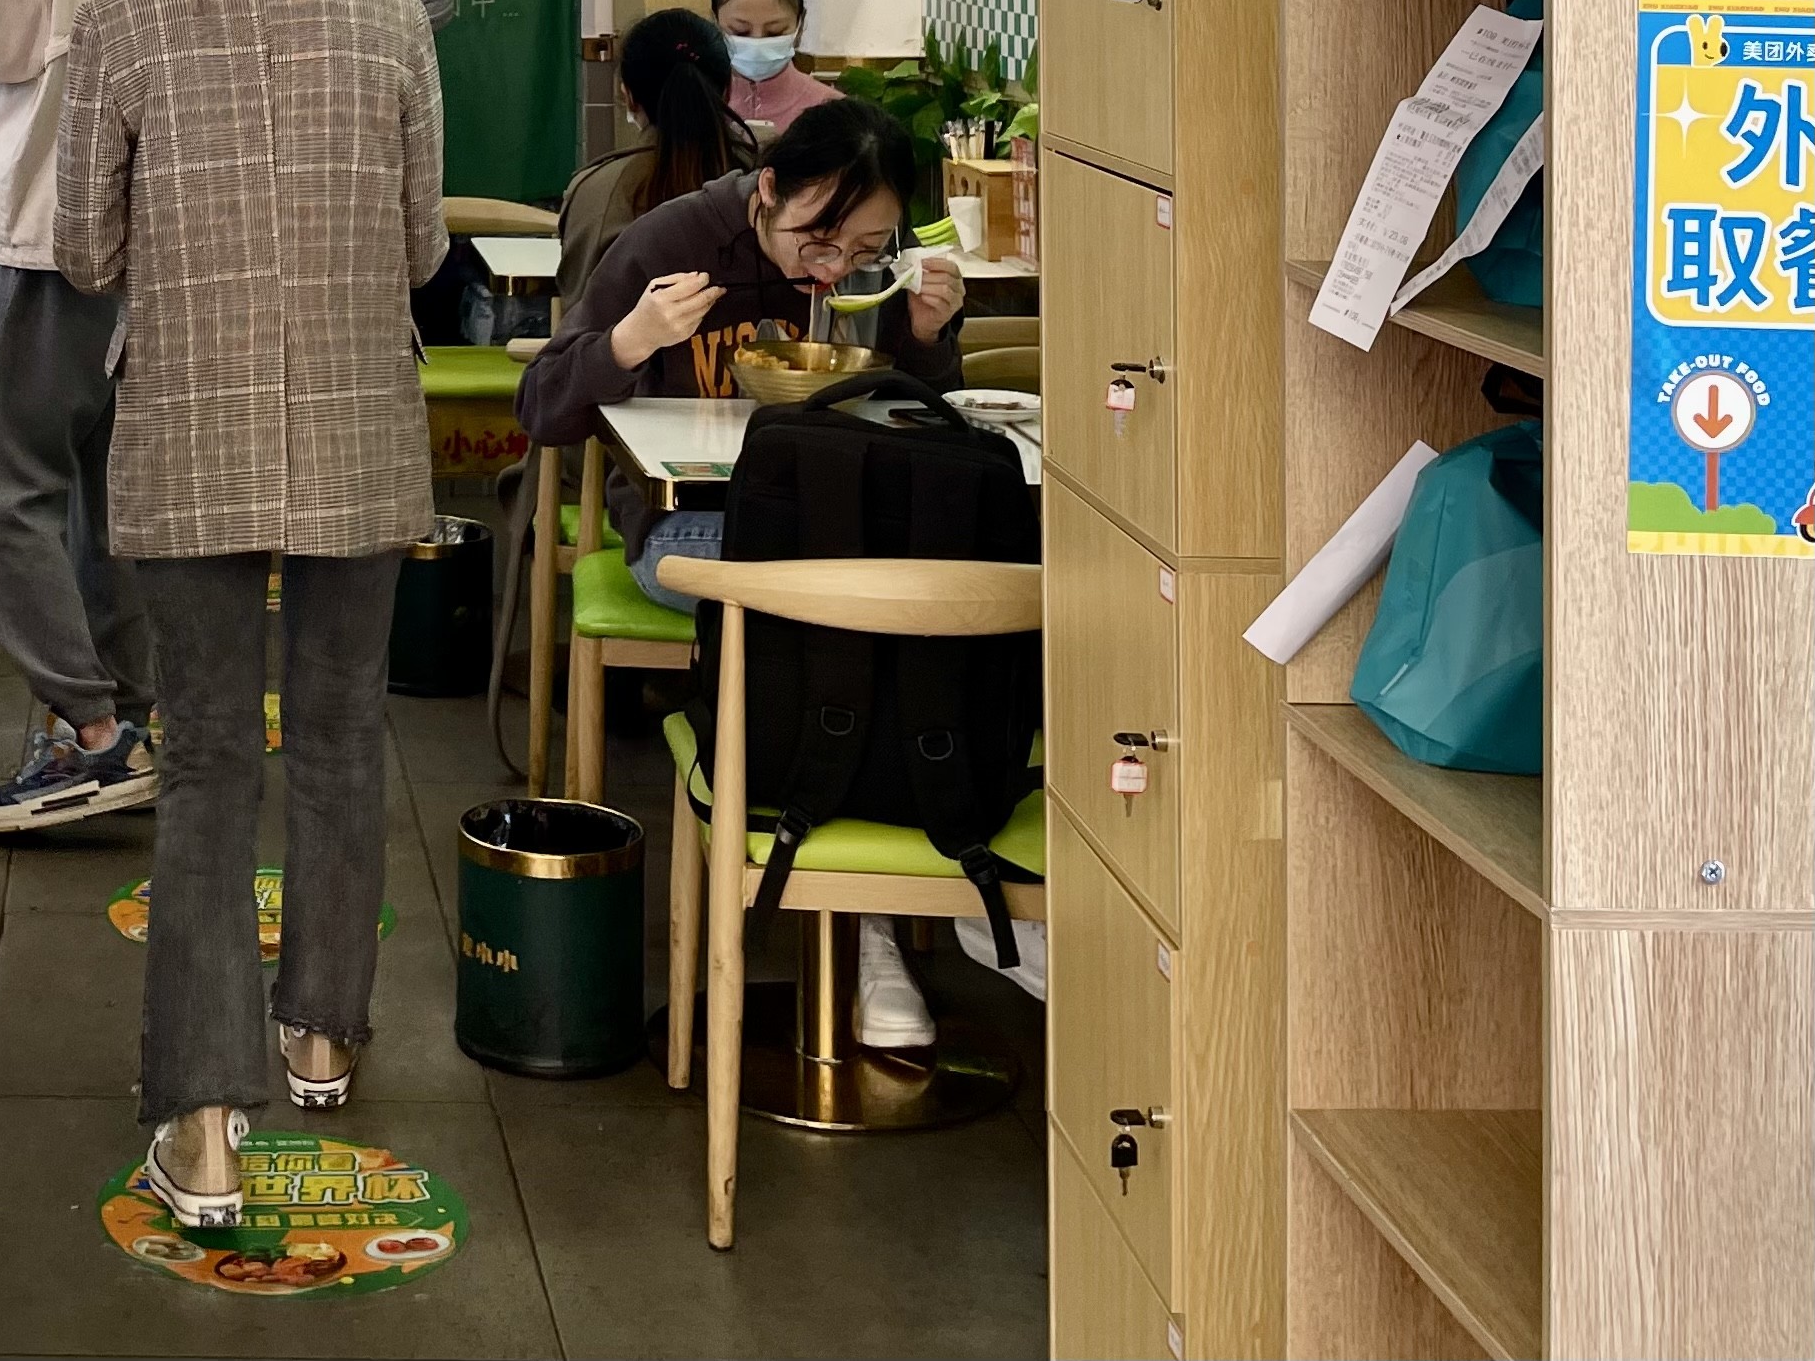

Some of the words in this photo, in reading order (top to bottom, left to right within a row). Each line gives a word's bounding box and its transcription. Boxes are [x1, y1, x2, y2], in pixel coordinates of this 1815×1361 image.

[1656, 355, 1735, 405] TAKE-OUT
[1735, 357, 1772, 408] FOOD
[241, 1172, 428, 1204] 世界杯
